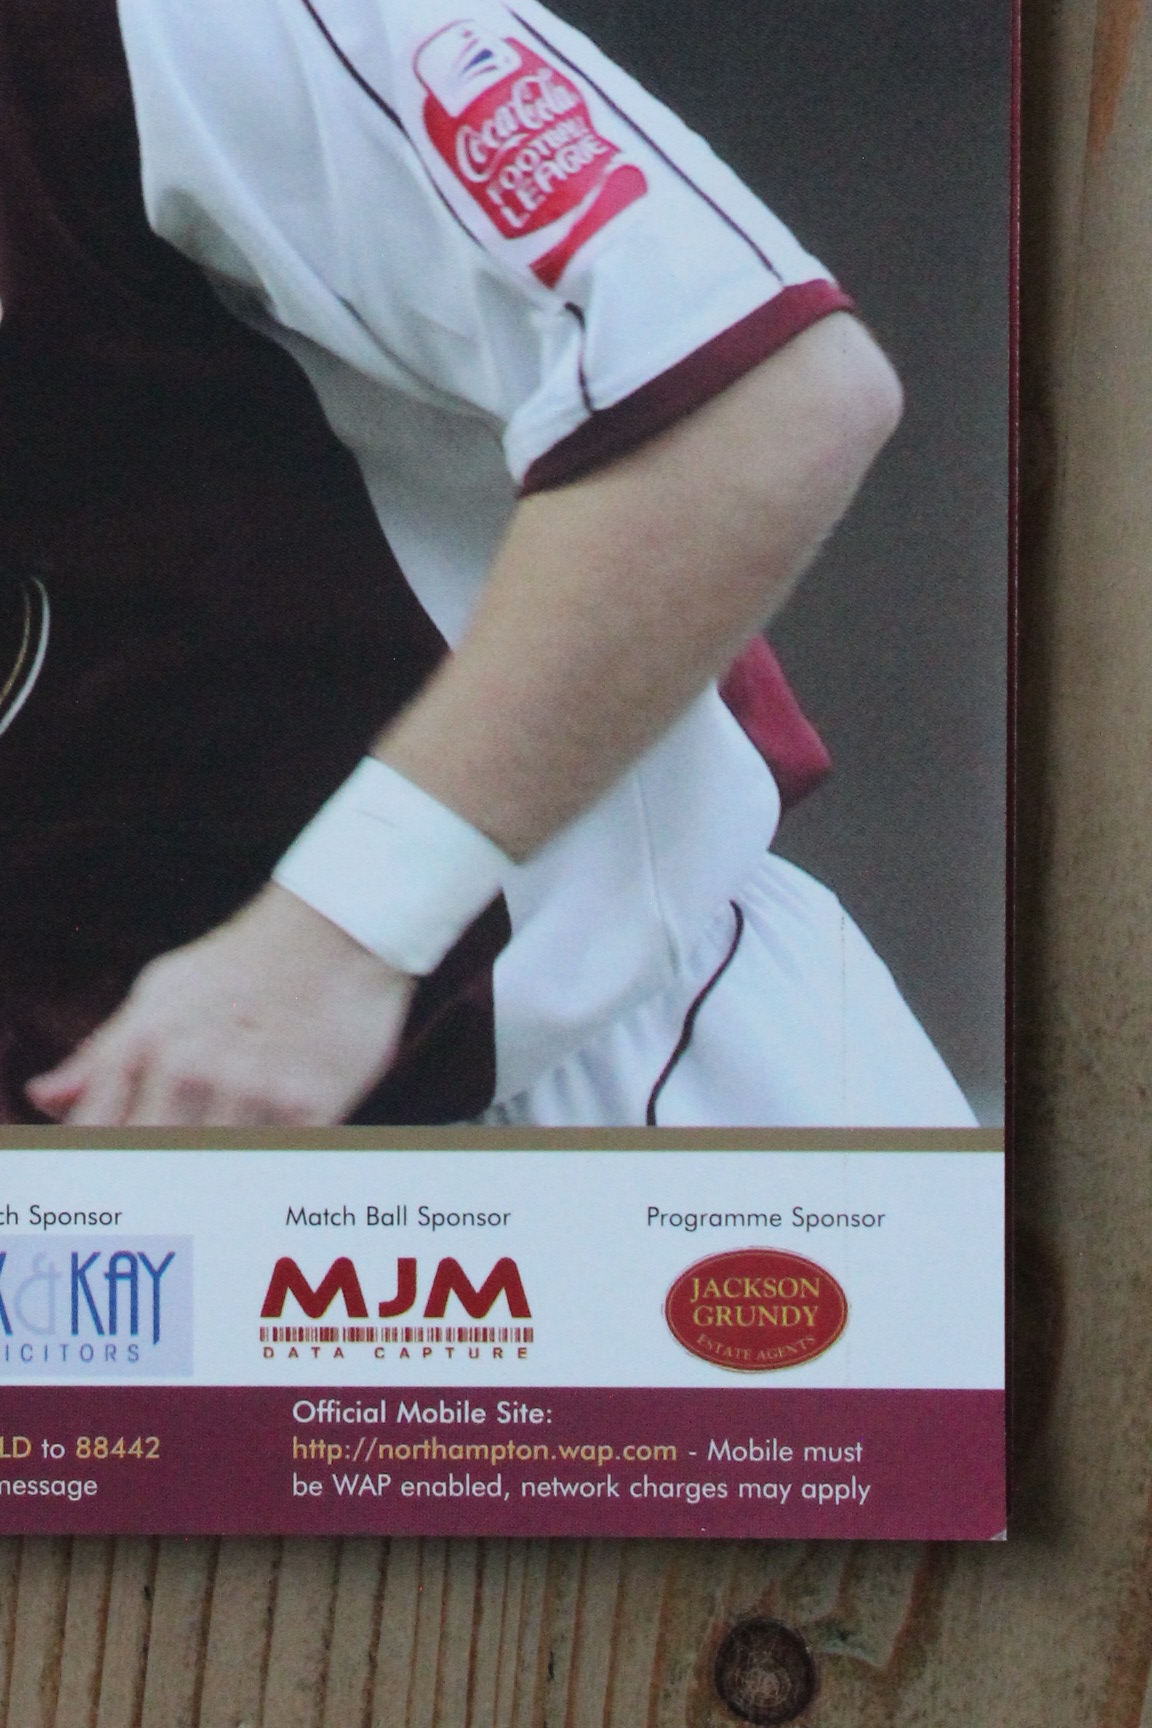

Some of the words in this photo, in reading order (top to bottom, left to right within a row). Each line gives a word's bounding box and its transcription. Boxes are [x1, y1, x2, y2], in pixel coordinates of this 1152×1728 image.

[30, 1205, 122, 1230] Sponsor
[286, 1206, 355, 1226] Match
[367, 1205, 407, 1226] Ball
[418, 1206, 510, 1231] Sponsor
[648, 1206, 782, 1232] Programme
[792, 1206, 885, 1232] Sponsor
[71, 1250, 176, 1346] KAY
[260, 1256, 532, 1318] MJM
[690, 1277, 820, 1303] JACKSON
[693, 1305, 818, 1327] GRUNDY
[263, 1346, 345, 1359] DATA
[374, 1346, 528, 1359] CAPTURE
[293, 1400, 385, 1423] Official
[397, 1400, 486, 1423] Mobile
[497, 1401, 551, 1424] Site:
[42, 1439, 65, 1459] to
[76, 1436, 159, 1458] 88442
[293, 1436, 676, 1466] http://northampton.wap.com
[708, 1438, 793, 1461] Mobile
[804, 1442, 863, 1462] must
[293, 1473, 322, 1496] be
[332, 1474, 391, 1496] WAP
[401, 1473, 509, 1500] enabled,
[522, 1474, 619, 1497] network
[630, 1474, 728, 1504] charges
[739, 1483, 791, 1504] may
[802, 1476, 870, 1505] apply
